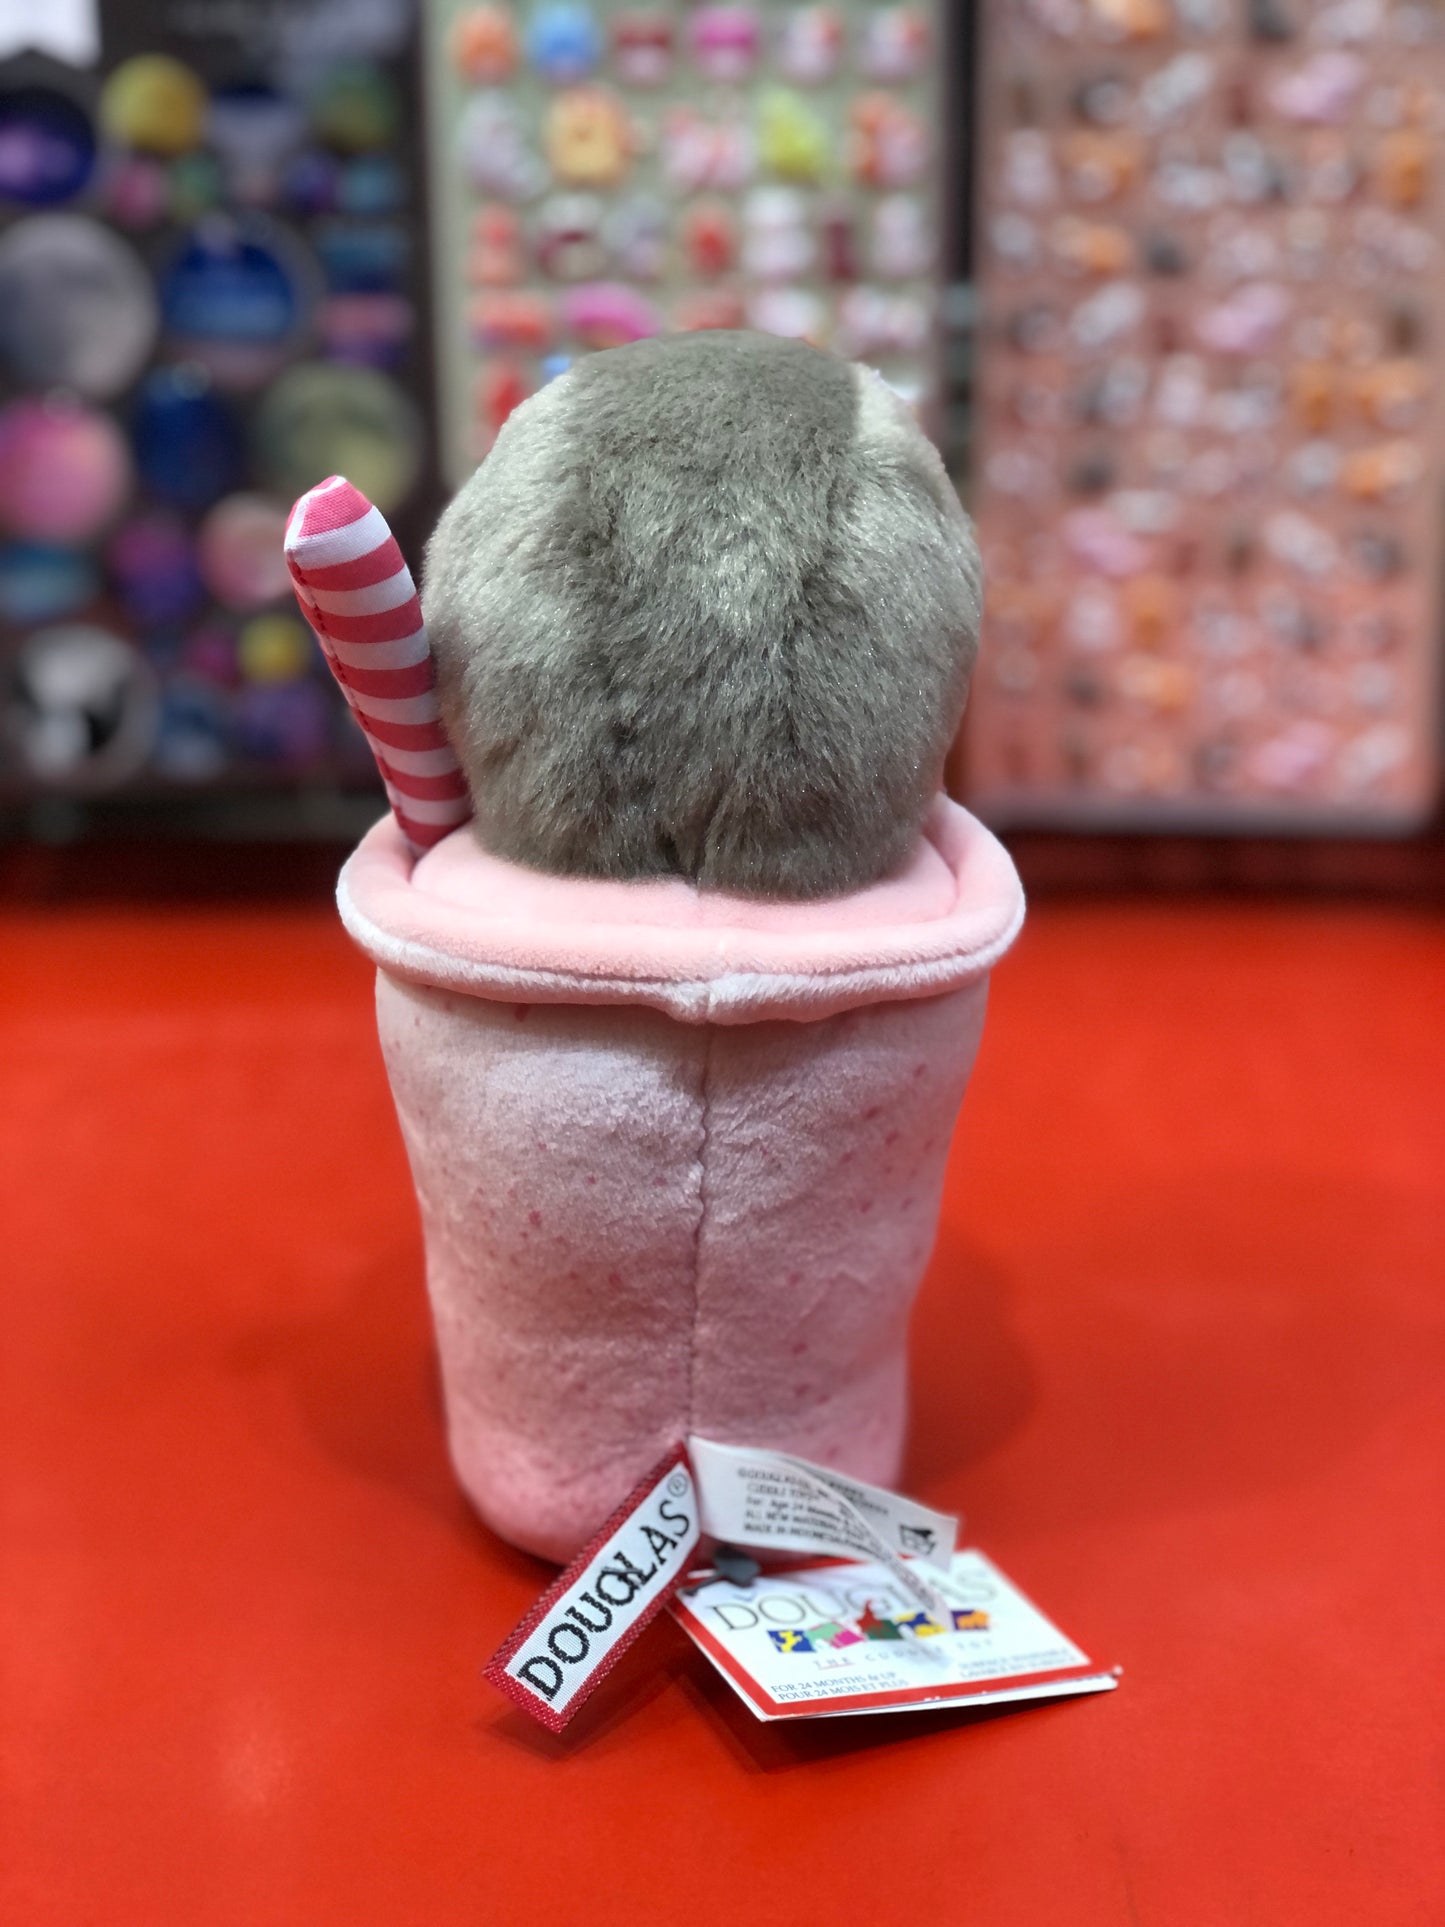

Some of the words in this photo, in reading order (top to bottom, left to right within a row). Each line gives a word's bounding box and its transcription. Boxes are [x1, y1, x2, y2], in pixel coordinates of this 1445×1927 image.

[771, 1683, 797, 1693] FOR
[798, 1681, 813, 1690] 24
[813, 1673, 867, 1688] MONTHS
[778, 1690, 813, 1701] POUR
[815, 1687, 829, 1697] 24
[830, 1684, 861, 1696] MOIS
